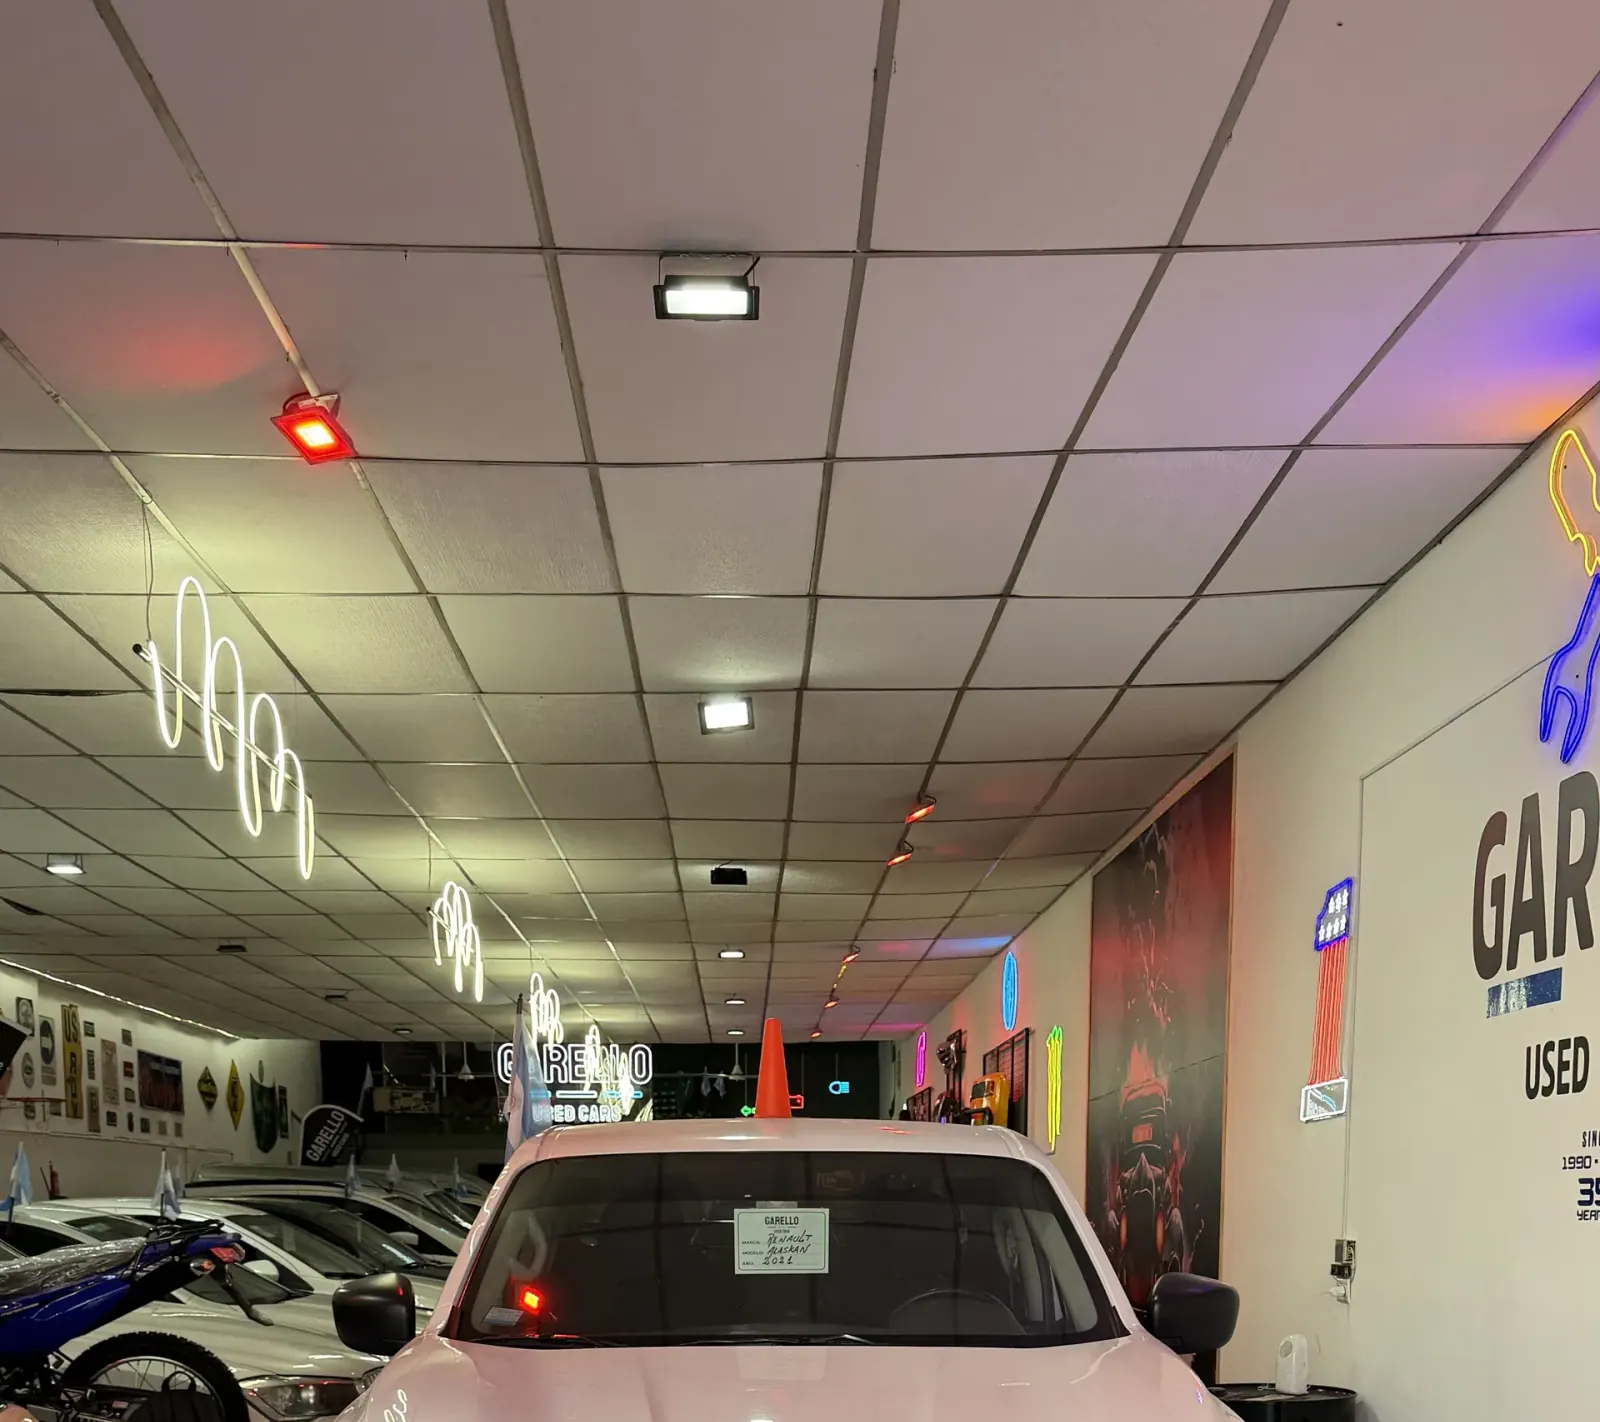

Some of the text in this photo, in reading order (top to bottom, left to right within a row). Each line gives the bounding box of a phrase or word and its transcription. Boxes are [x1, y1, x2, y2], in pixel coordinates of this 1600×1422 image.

[1525, 1036, 1590, 1100] USED
[577, 1104, 621, 1122] CARS
[306, 1110, 345, 1162] GARELLO
[1582, 1130, 1600, 1148] SIN
[1562, 1155, 1592, 1170] 1990
[764, 1216, 800, 1226] GARELLO
[767, 1229, 813, 1249] RENAULT
[762, 1255, 794, 1265] 2021
[767, 1243, 811, 1259] ALASKAN
